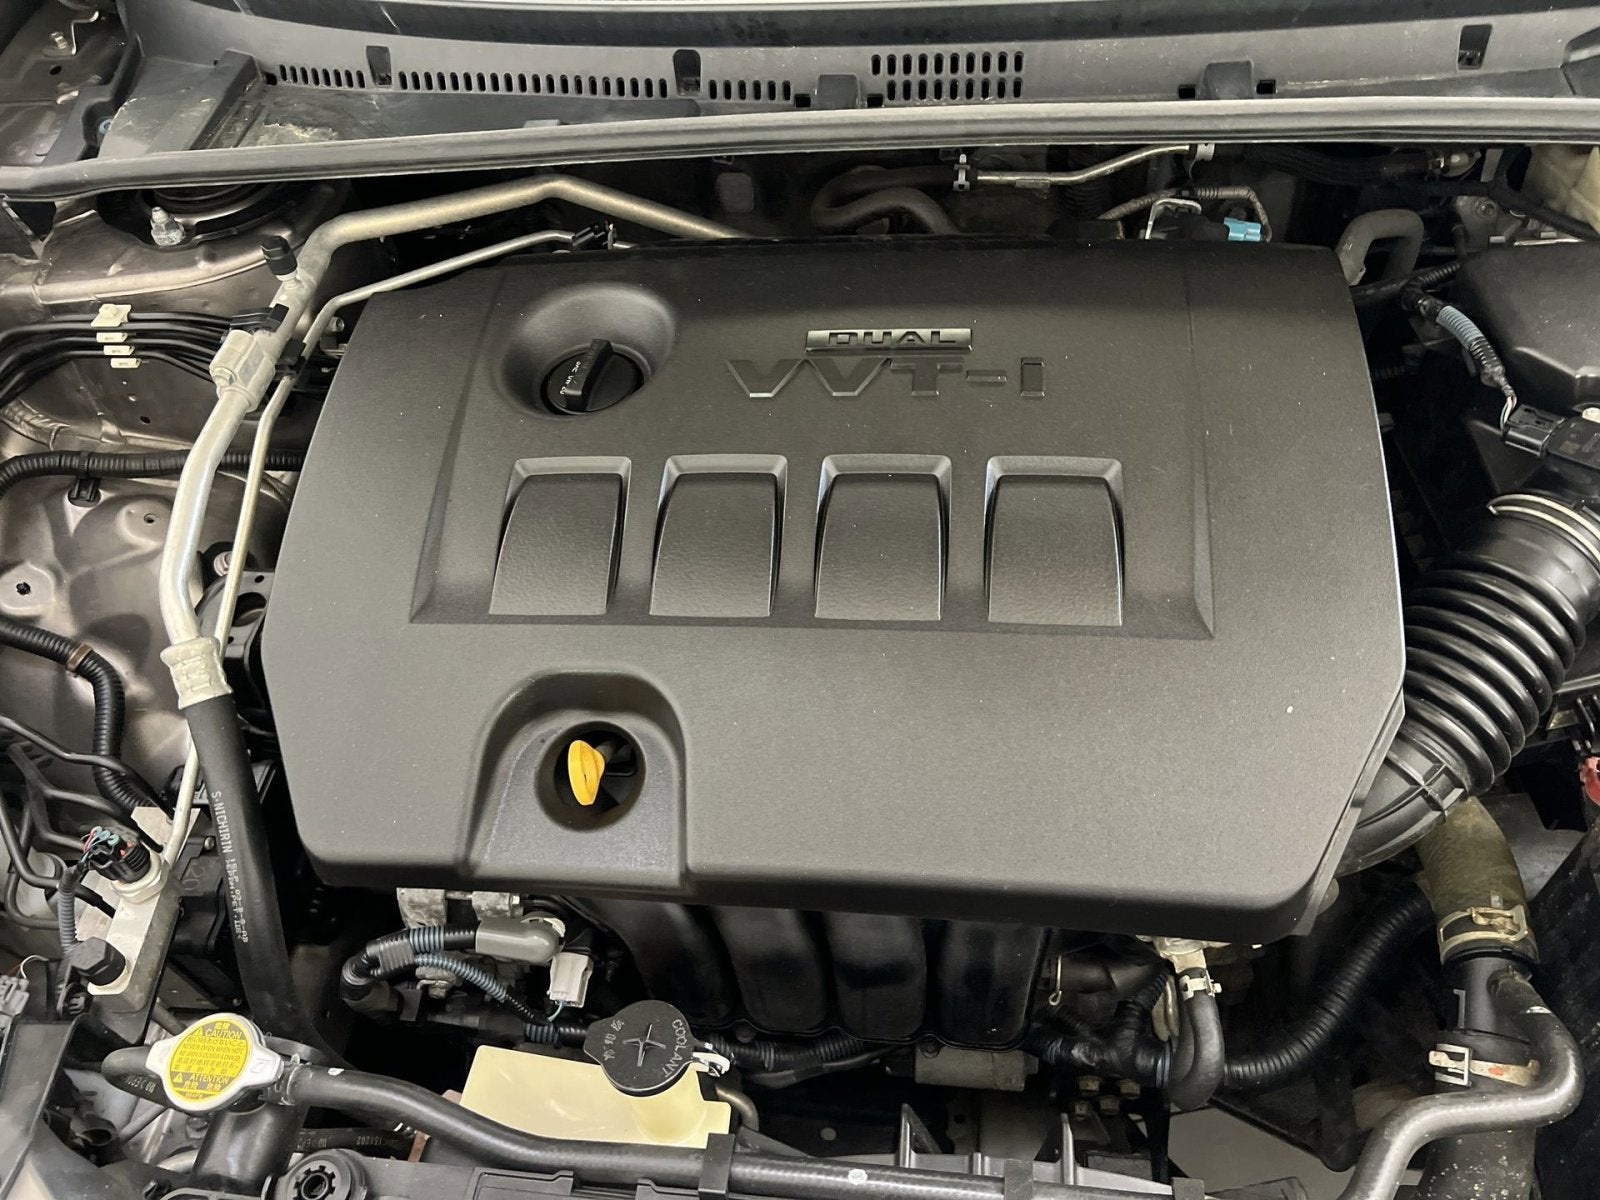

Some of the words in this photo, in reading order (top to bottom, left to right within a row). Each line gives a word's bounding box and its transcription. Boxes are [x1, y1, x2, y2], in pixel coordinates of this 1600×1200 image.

[828, 330, 957, 345] DUAL
[205, 1028, 243, 1039] CAUTION
[200, 1044, 215, 1052] OPEN
[662, 1019, 688, 1078] COOLANT
[189, 1074, 230, 1084] ATTENTION
